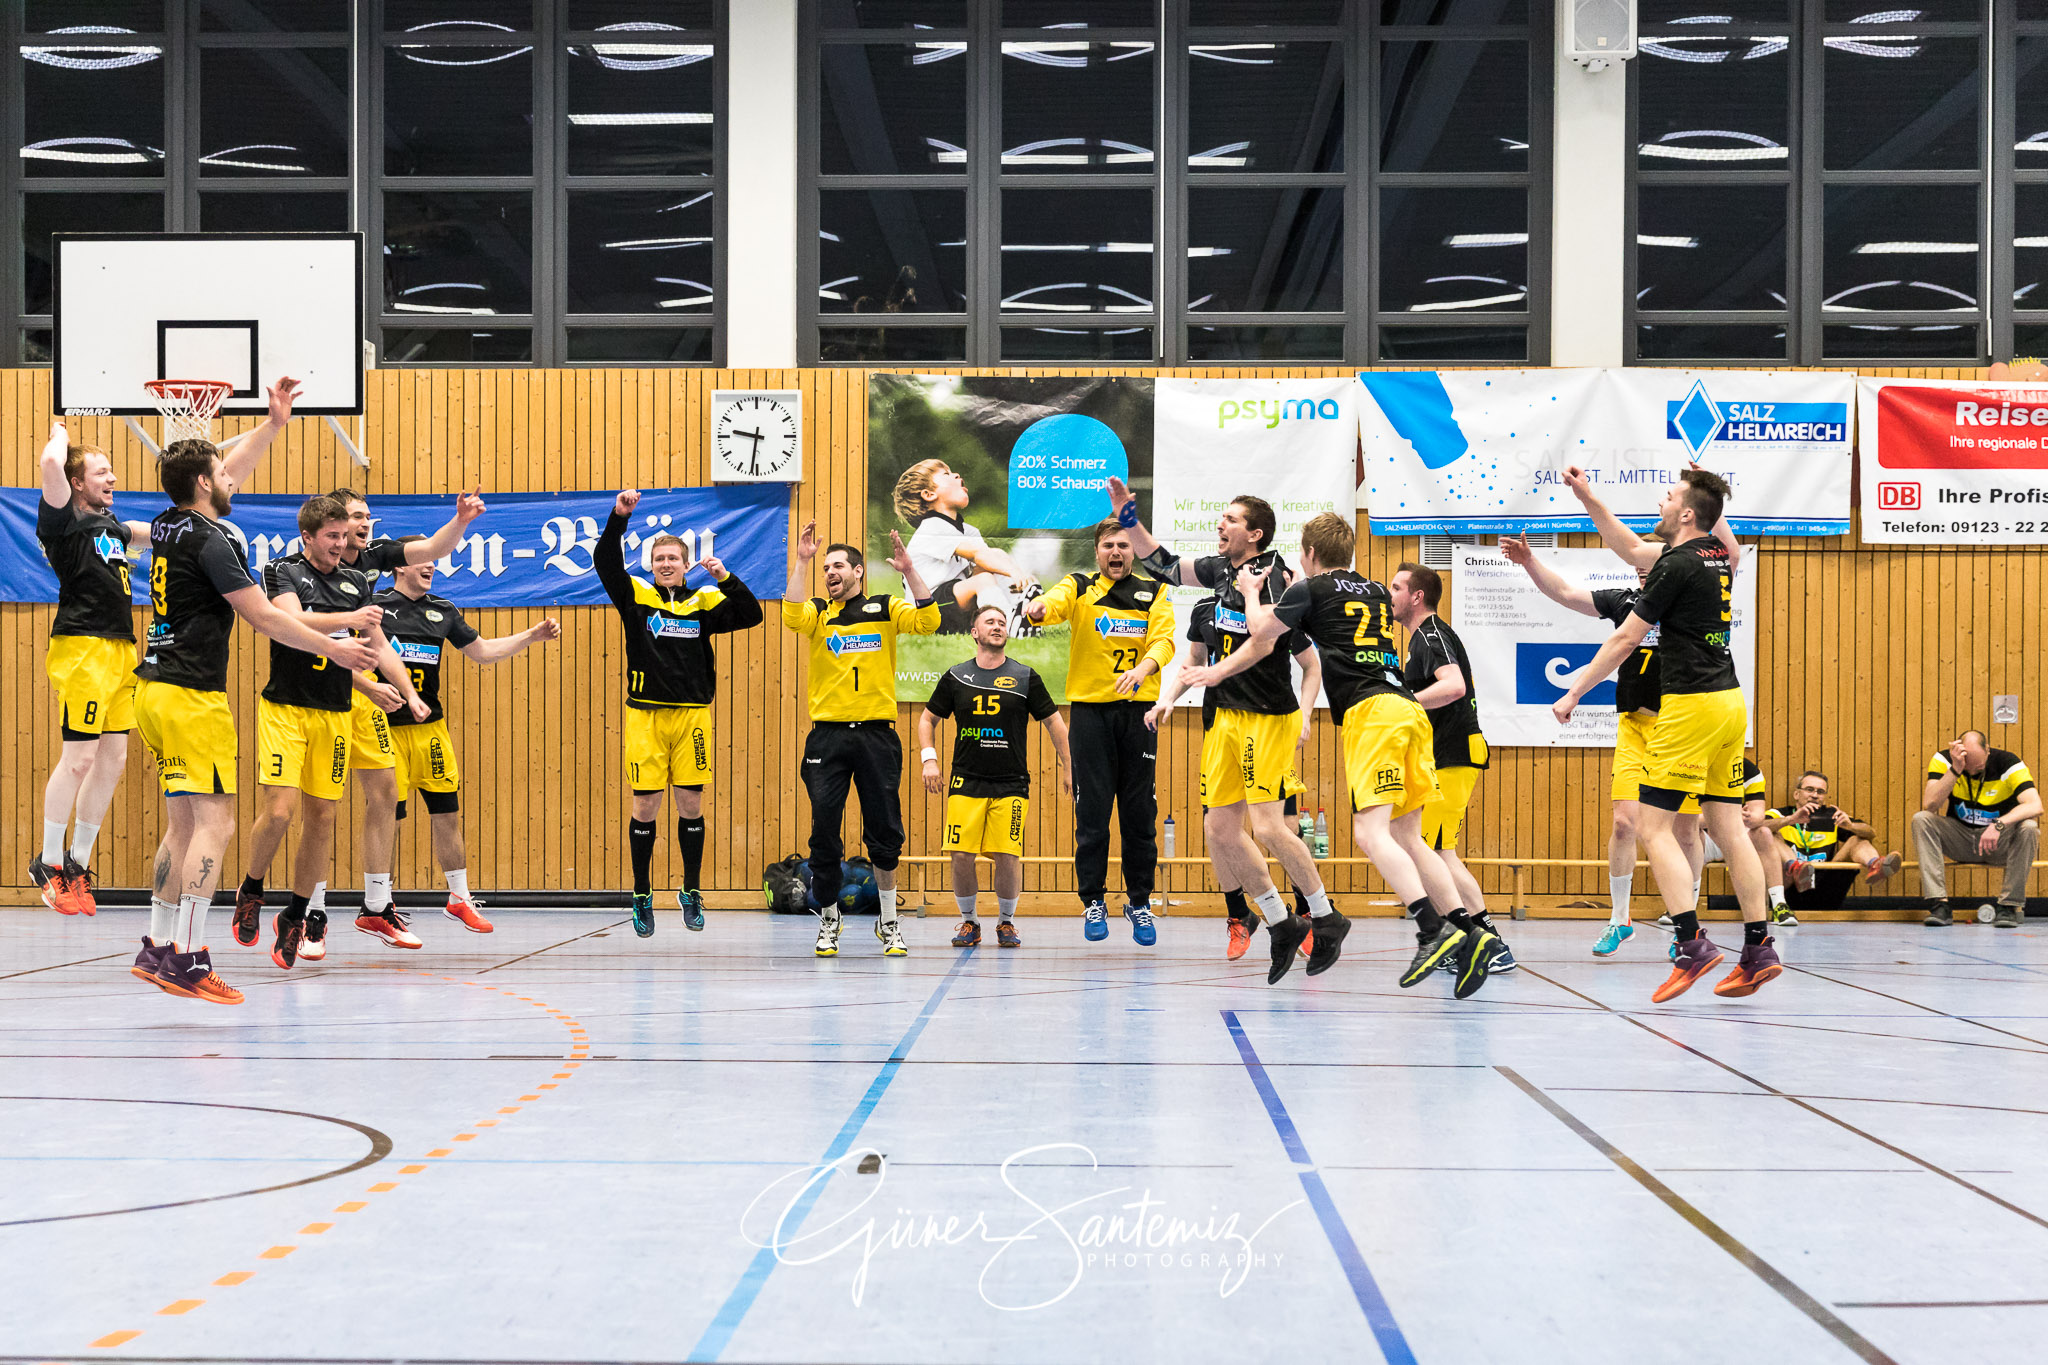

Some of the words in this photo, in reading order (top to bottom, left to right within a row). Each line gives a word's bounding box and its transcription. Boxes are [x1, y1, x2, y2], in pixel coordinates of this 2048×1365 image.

[64, 408, 112, 416] ERHARD
[1218, 398, 1339, 429] psyma
[1728, 403, 1776, 422] SALZ
[1728, 423, 1844, 441] HELMREICH
[1950, 436, 1975, 448] Ihre
[1978, 436, 2037, 451] regionale
[1017, 455, 1047, 469] 20%
[1051, 455, 1107, 470] Schmerz
[1017, 475, 1047, 489] 80%
[1534, 470, 1562, 485] SAL
[1174, 499, 1194, 511] Wir
[1282, 499, 1334, 511] kreative
[1883, 487, 1916, 505] DB
[1939, 489, 1981, 503] Ihre
[1883, 521, 1945, 533] Telefon:
[1951, 521, 1999, 533] 09123
[2015, 521, 2034, 533] 22
[1464, 557, 1509, 566] Christian
[1333, 578, 1371, 595] JOST
[1113, 647, 1139, 673] 23
[1640, 648, 1653, 675] 7
[631, 670, 645, 693] 11
[852, 666, 859, 692] 1
[84, 700, 98, 725] 8
[972, 694, 1001, 716] 15
[961, 727, 1004, 741] psyma
[1247, 743, 1255, 781] MEIER
[1377, 768, 1401, 785] FRZ
[1015, 804, 1023, 837] MEIER
[948, 824, 961, 844] 15
